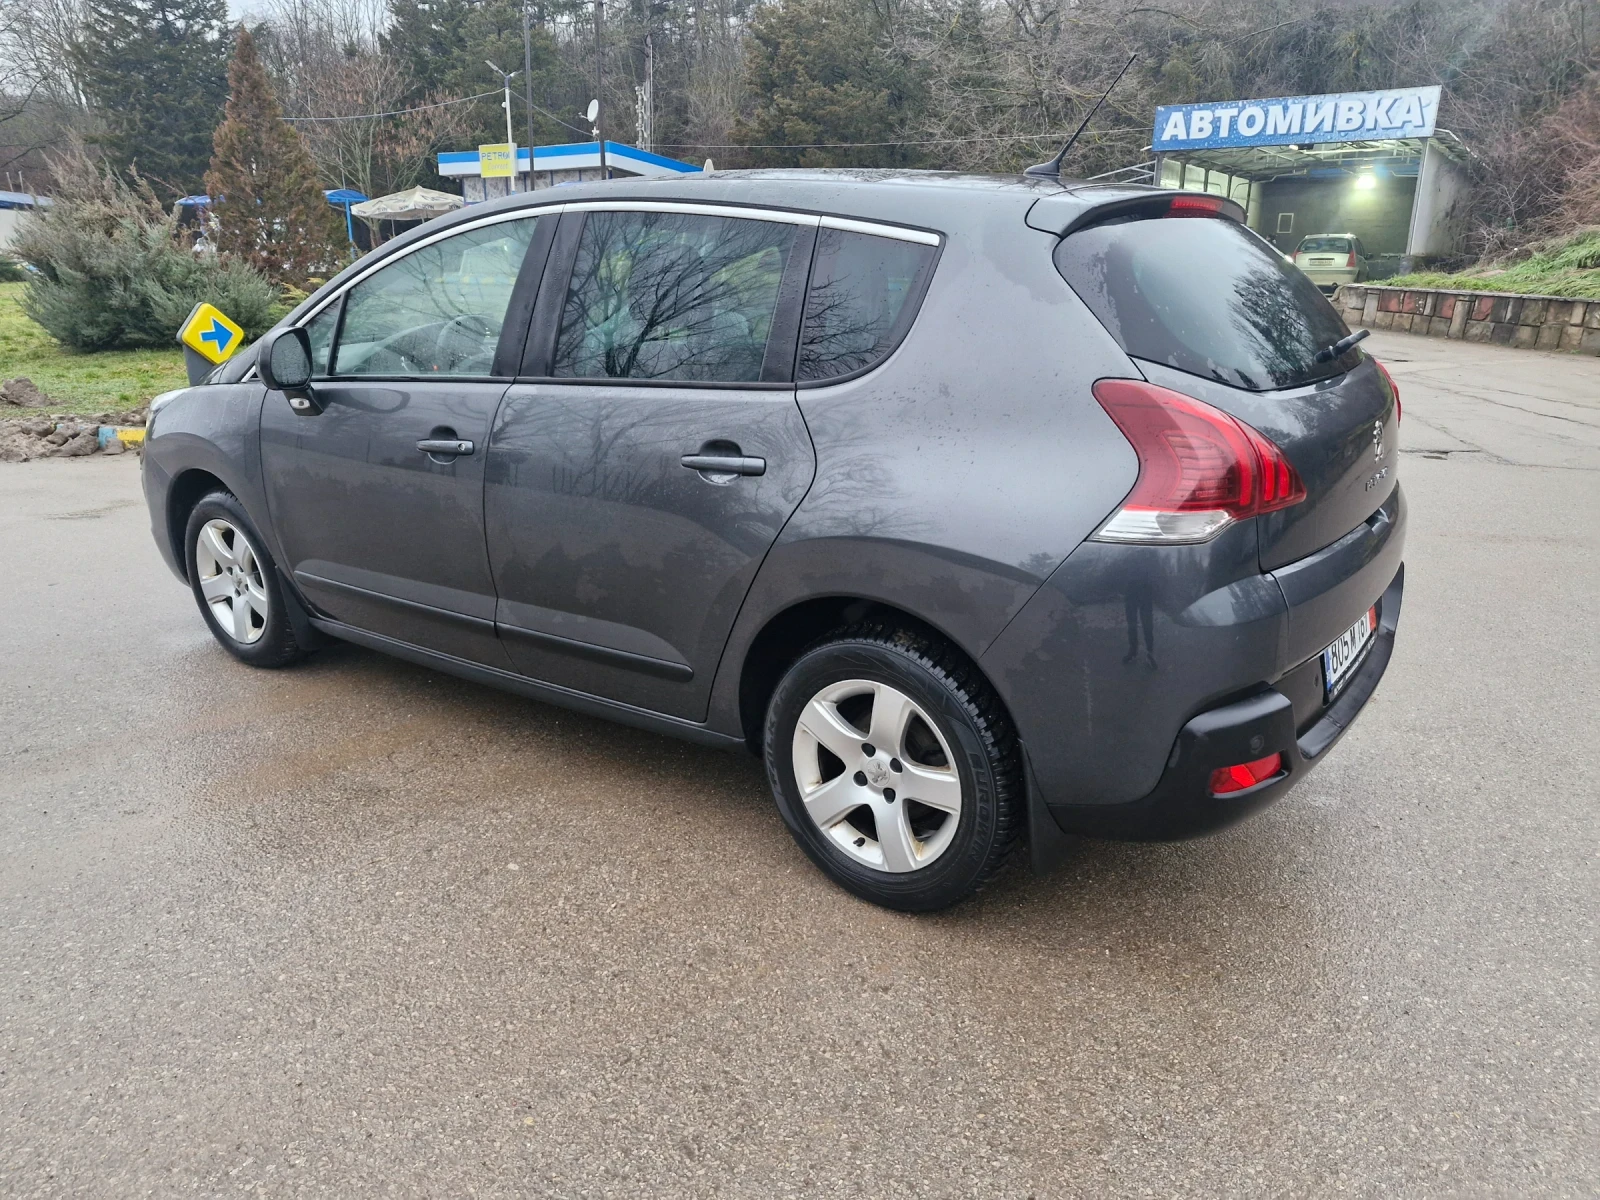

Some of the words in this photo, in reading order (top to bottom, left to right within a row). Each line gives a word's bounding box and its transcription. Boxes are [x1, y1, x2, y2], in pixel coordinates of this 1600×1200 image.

[1161, 95, 1424, 141] АВТОМИВКА
[1331, 636, 1349, 674] 805
[1350, 626, 1357, 654] M
